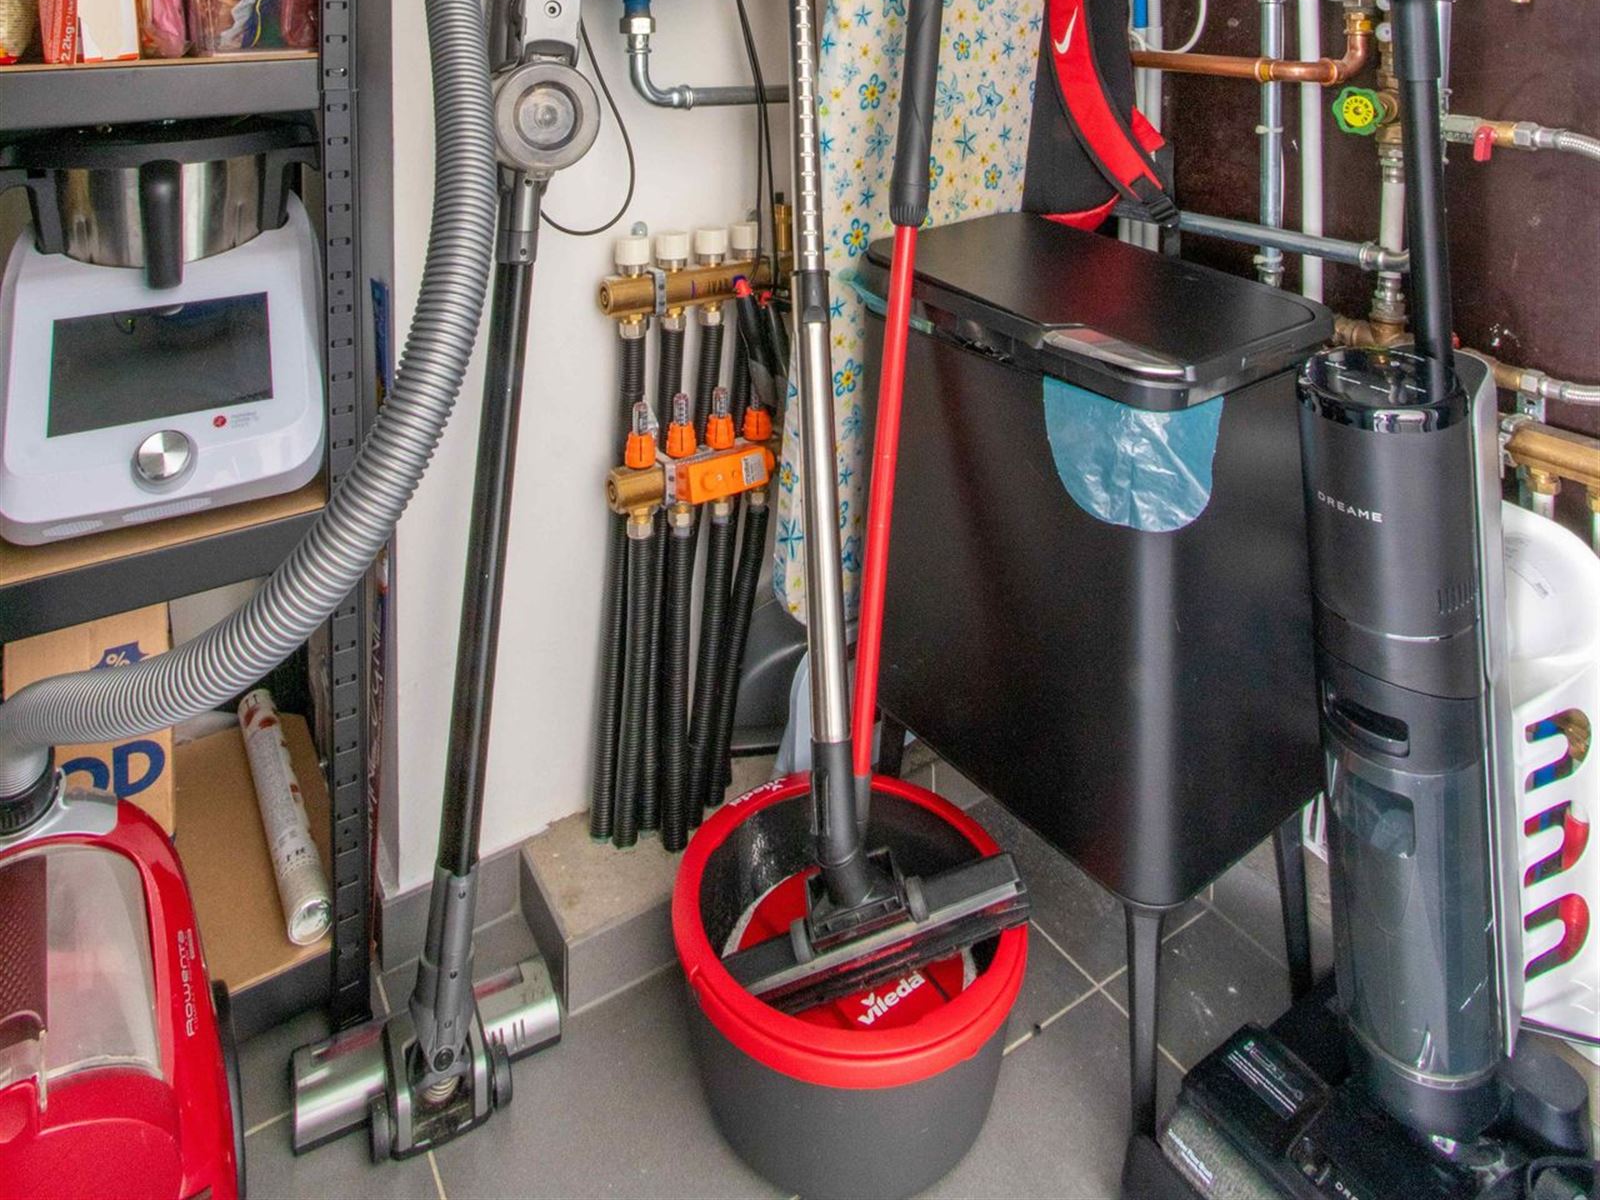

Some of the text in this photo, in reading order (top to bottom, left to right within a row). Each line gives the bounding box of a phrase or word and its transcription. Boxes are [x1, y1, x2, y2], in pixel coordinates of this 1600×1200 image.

[61, 26, 75, 62] 2.2kg
[1317, 490, 1383, 524] DREAME
[857, 972, 926, 1025] vileda
